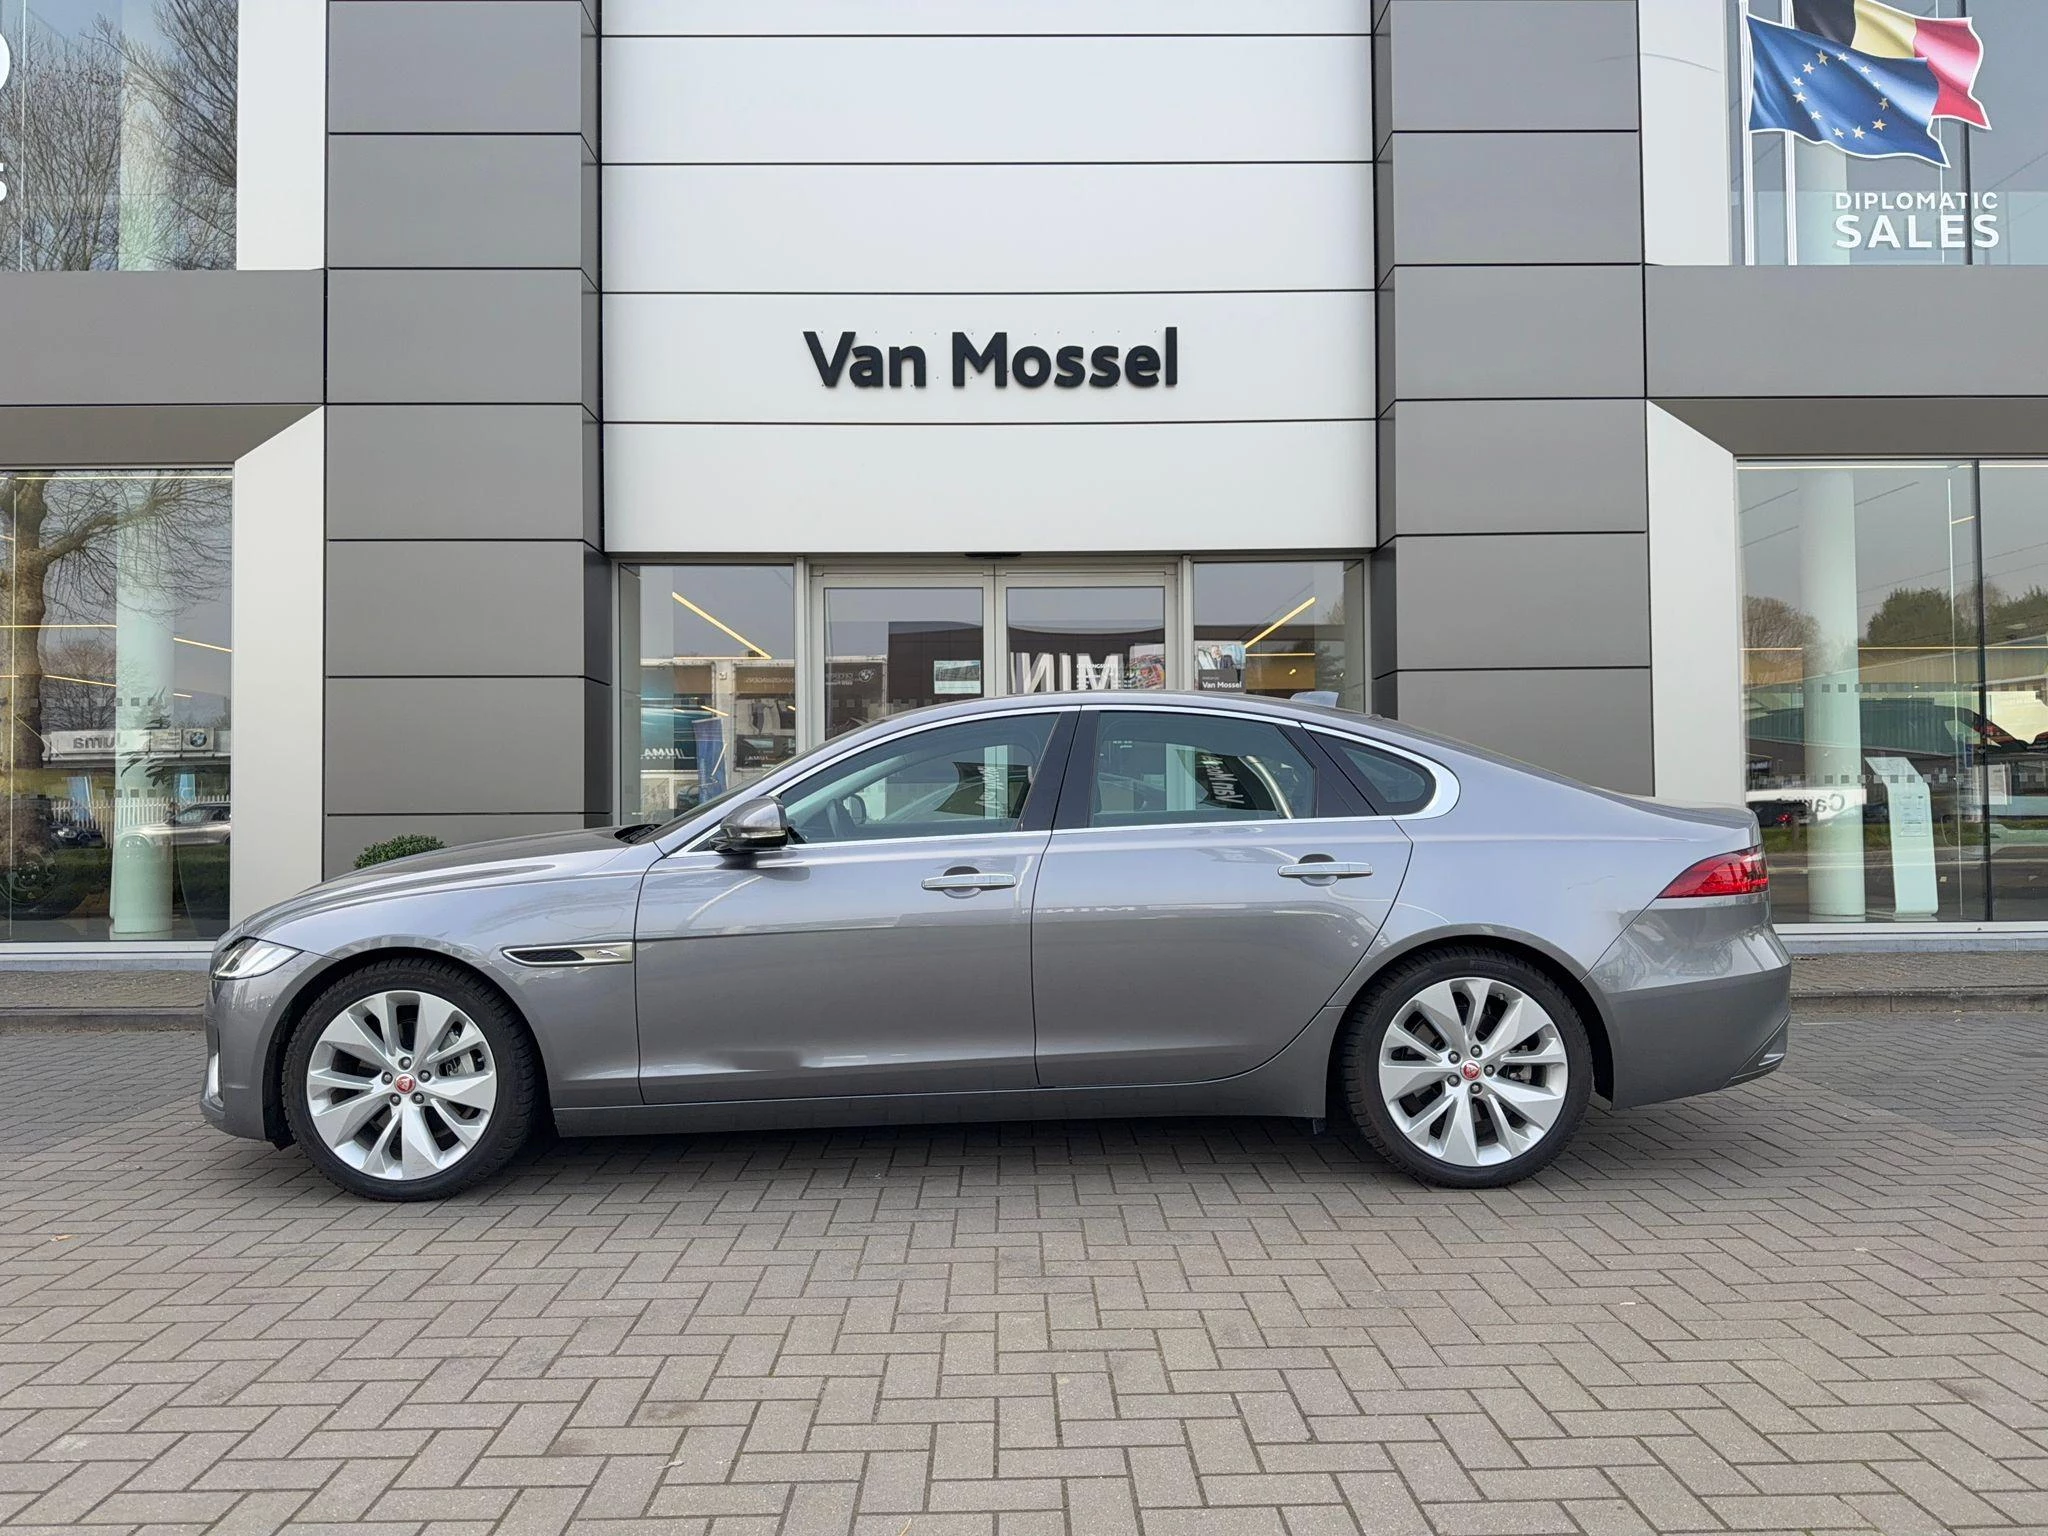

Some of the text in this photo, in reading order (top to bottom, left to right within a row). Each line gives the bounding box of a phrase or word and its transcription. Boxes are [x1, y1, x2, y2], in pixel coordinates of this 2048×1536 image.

[1835, 191, 1999, 210] DIPLOMATIC
[1835, 214, 2000, 249] SALES
[802, 326, 1178, 388] Van Mossel
[1202, 680, 1242, 689] Van Mossel
